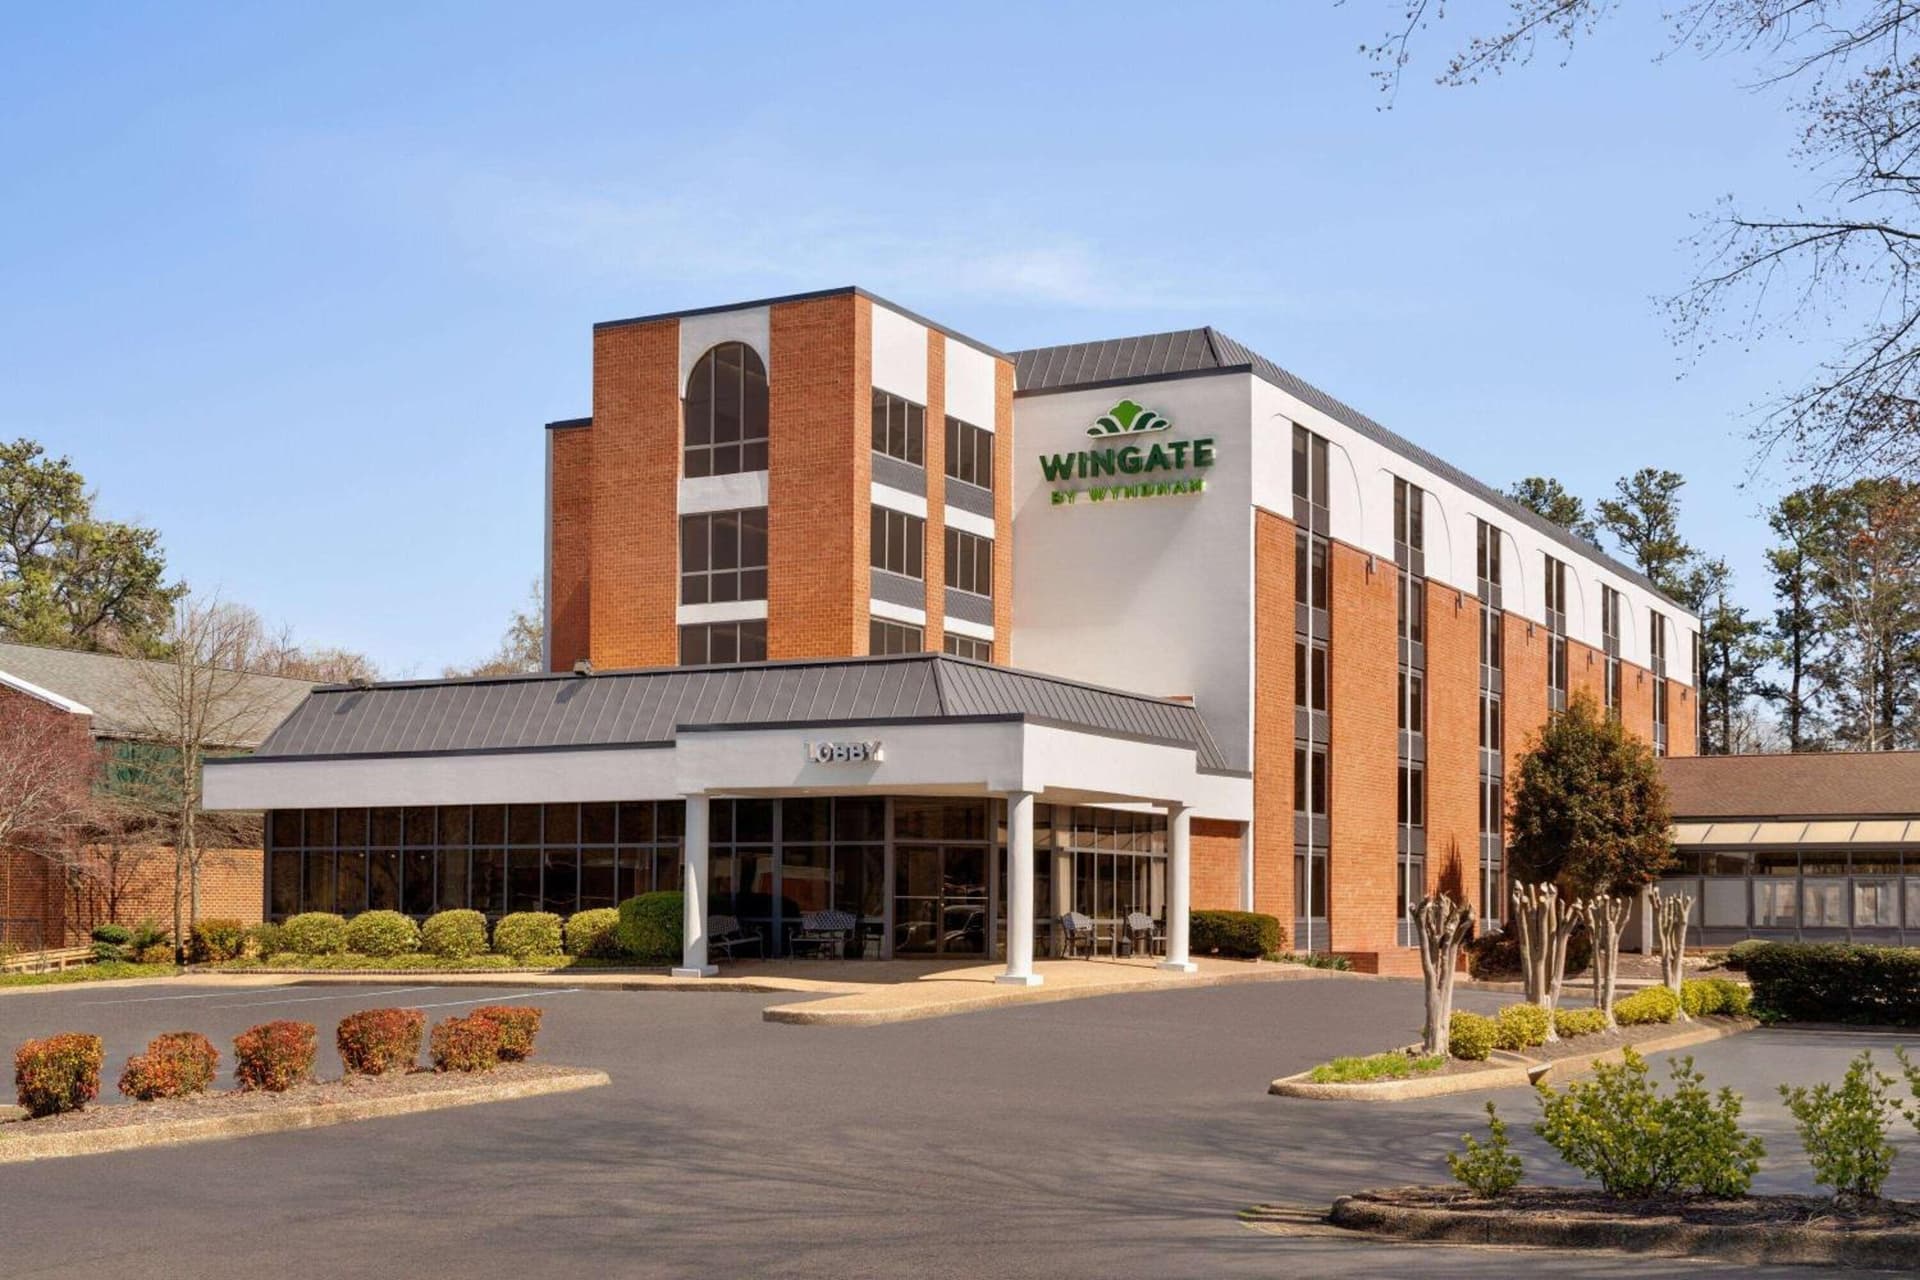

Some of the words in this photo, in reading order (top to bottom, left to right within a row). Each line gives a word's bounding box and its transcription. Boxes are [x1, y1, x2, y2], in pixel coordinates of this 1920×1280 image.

[1039, 438, 1214, 482] WINGATE
[1051, 490, 1076, 505] BY
[1088, 479, 1205, 502] WYNDHAM
[804, 740, 882, 762] LOBBY
